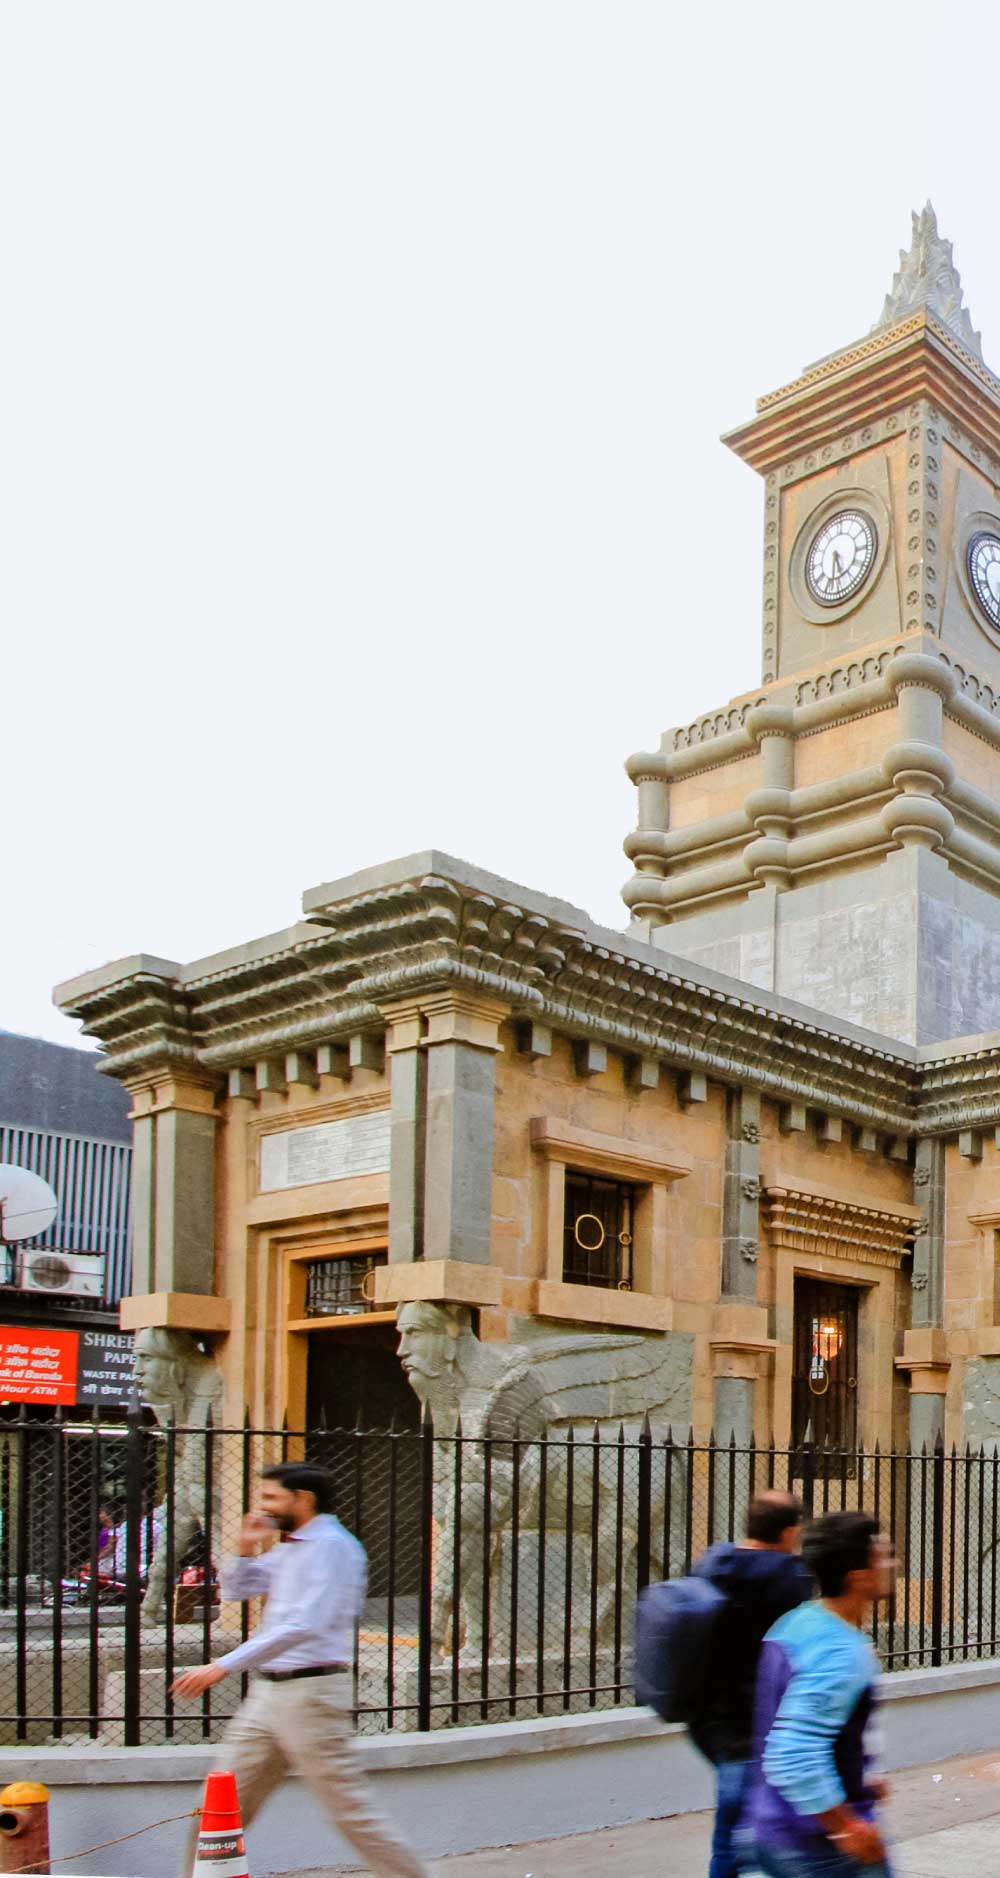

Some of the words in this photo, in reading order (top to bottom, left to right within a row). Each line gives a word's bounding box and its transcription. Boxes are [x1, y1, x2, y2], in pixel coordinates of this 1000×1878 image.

[84, 1332, 136, 1348] SHREE
[12, 1369, 25, 1378] of
[25, 1370, 63, 1381] Baroda
[82, 1370, 118, 1380] WASTE
[0, 1384, 30, 1394] Hour
[31, 1386, 59, 1396] ATM
